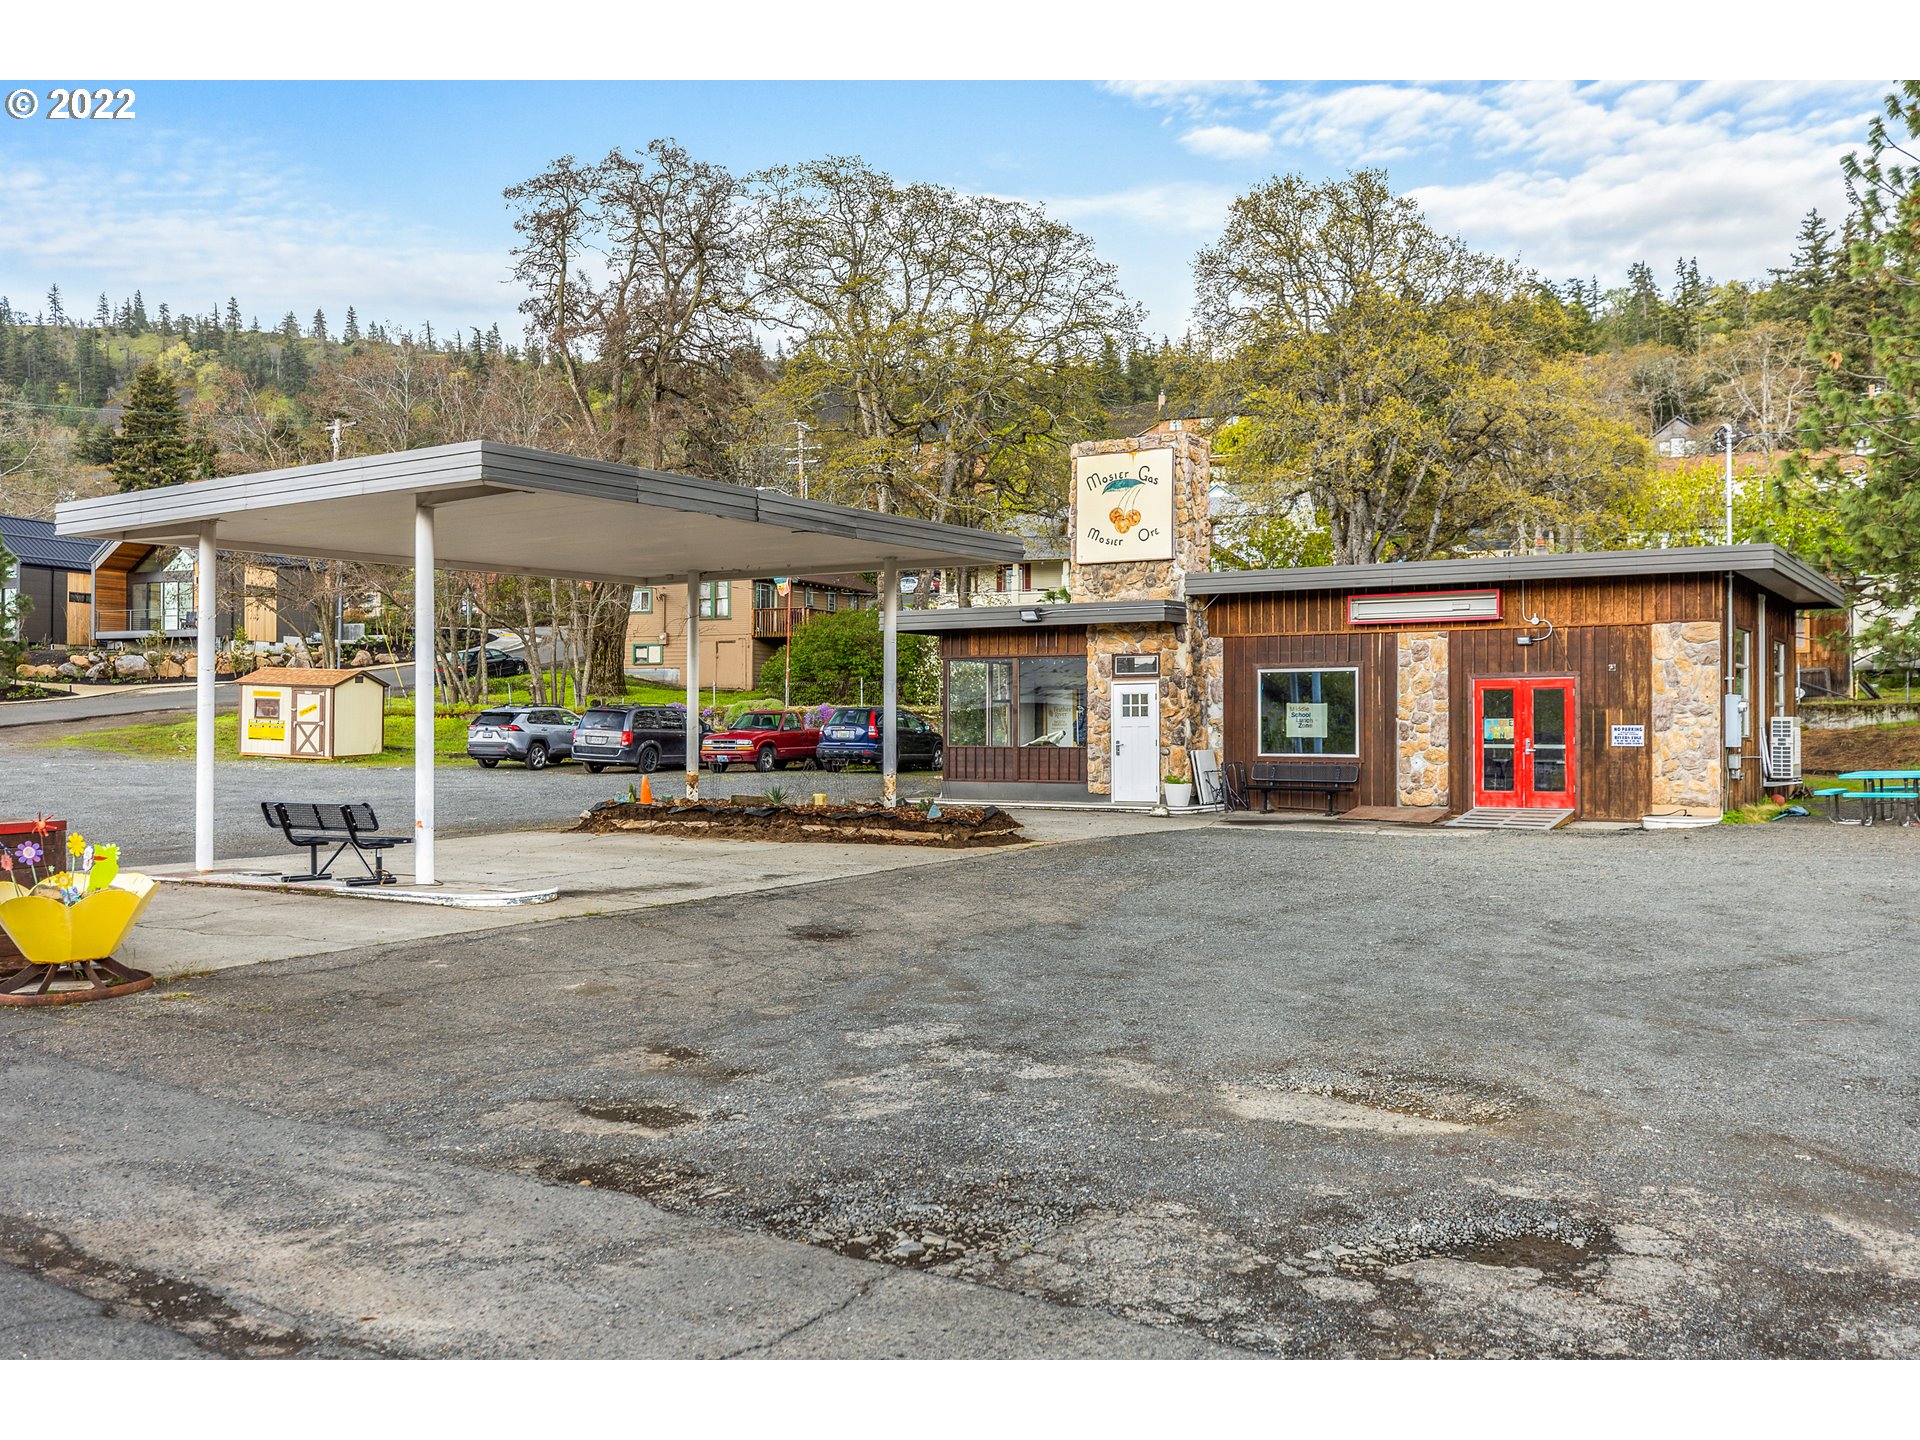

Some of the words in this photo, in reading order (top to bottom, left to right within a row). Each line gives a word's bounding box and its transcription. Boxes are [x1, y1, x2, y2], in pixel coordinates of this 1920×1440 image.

[1086, 471, 1129, 491] Mosier
[1138, 465, 1159, 485] Gas
[1087, 527, 1124, 546] Mosier
[1138, 528, 1160, 542] Ore
